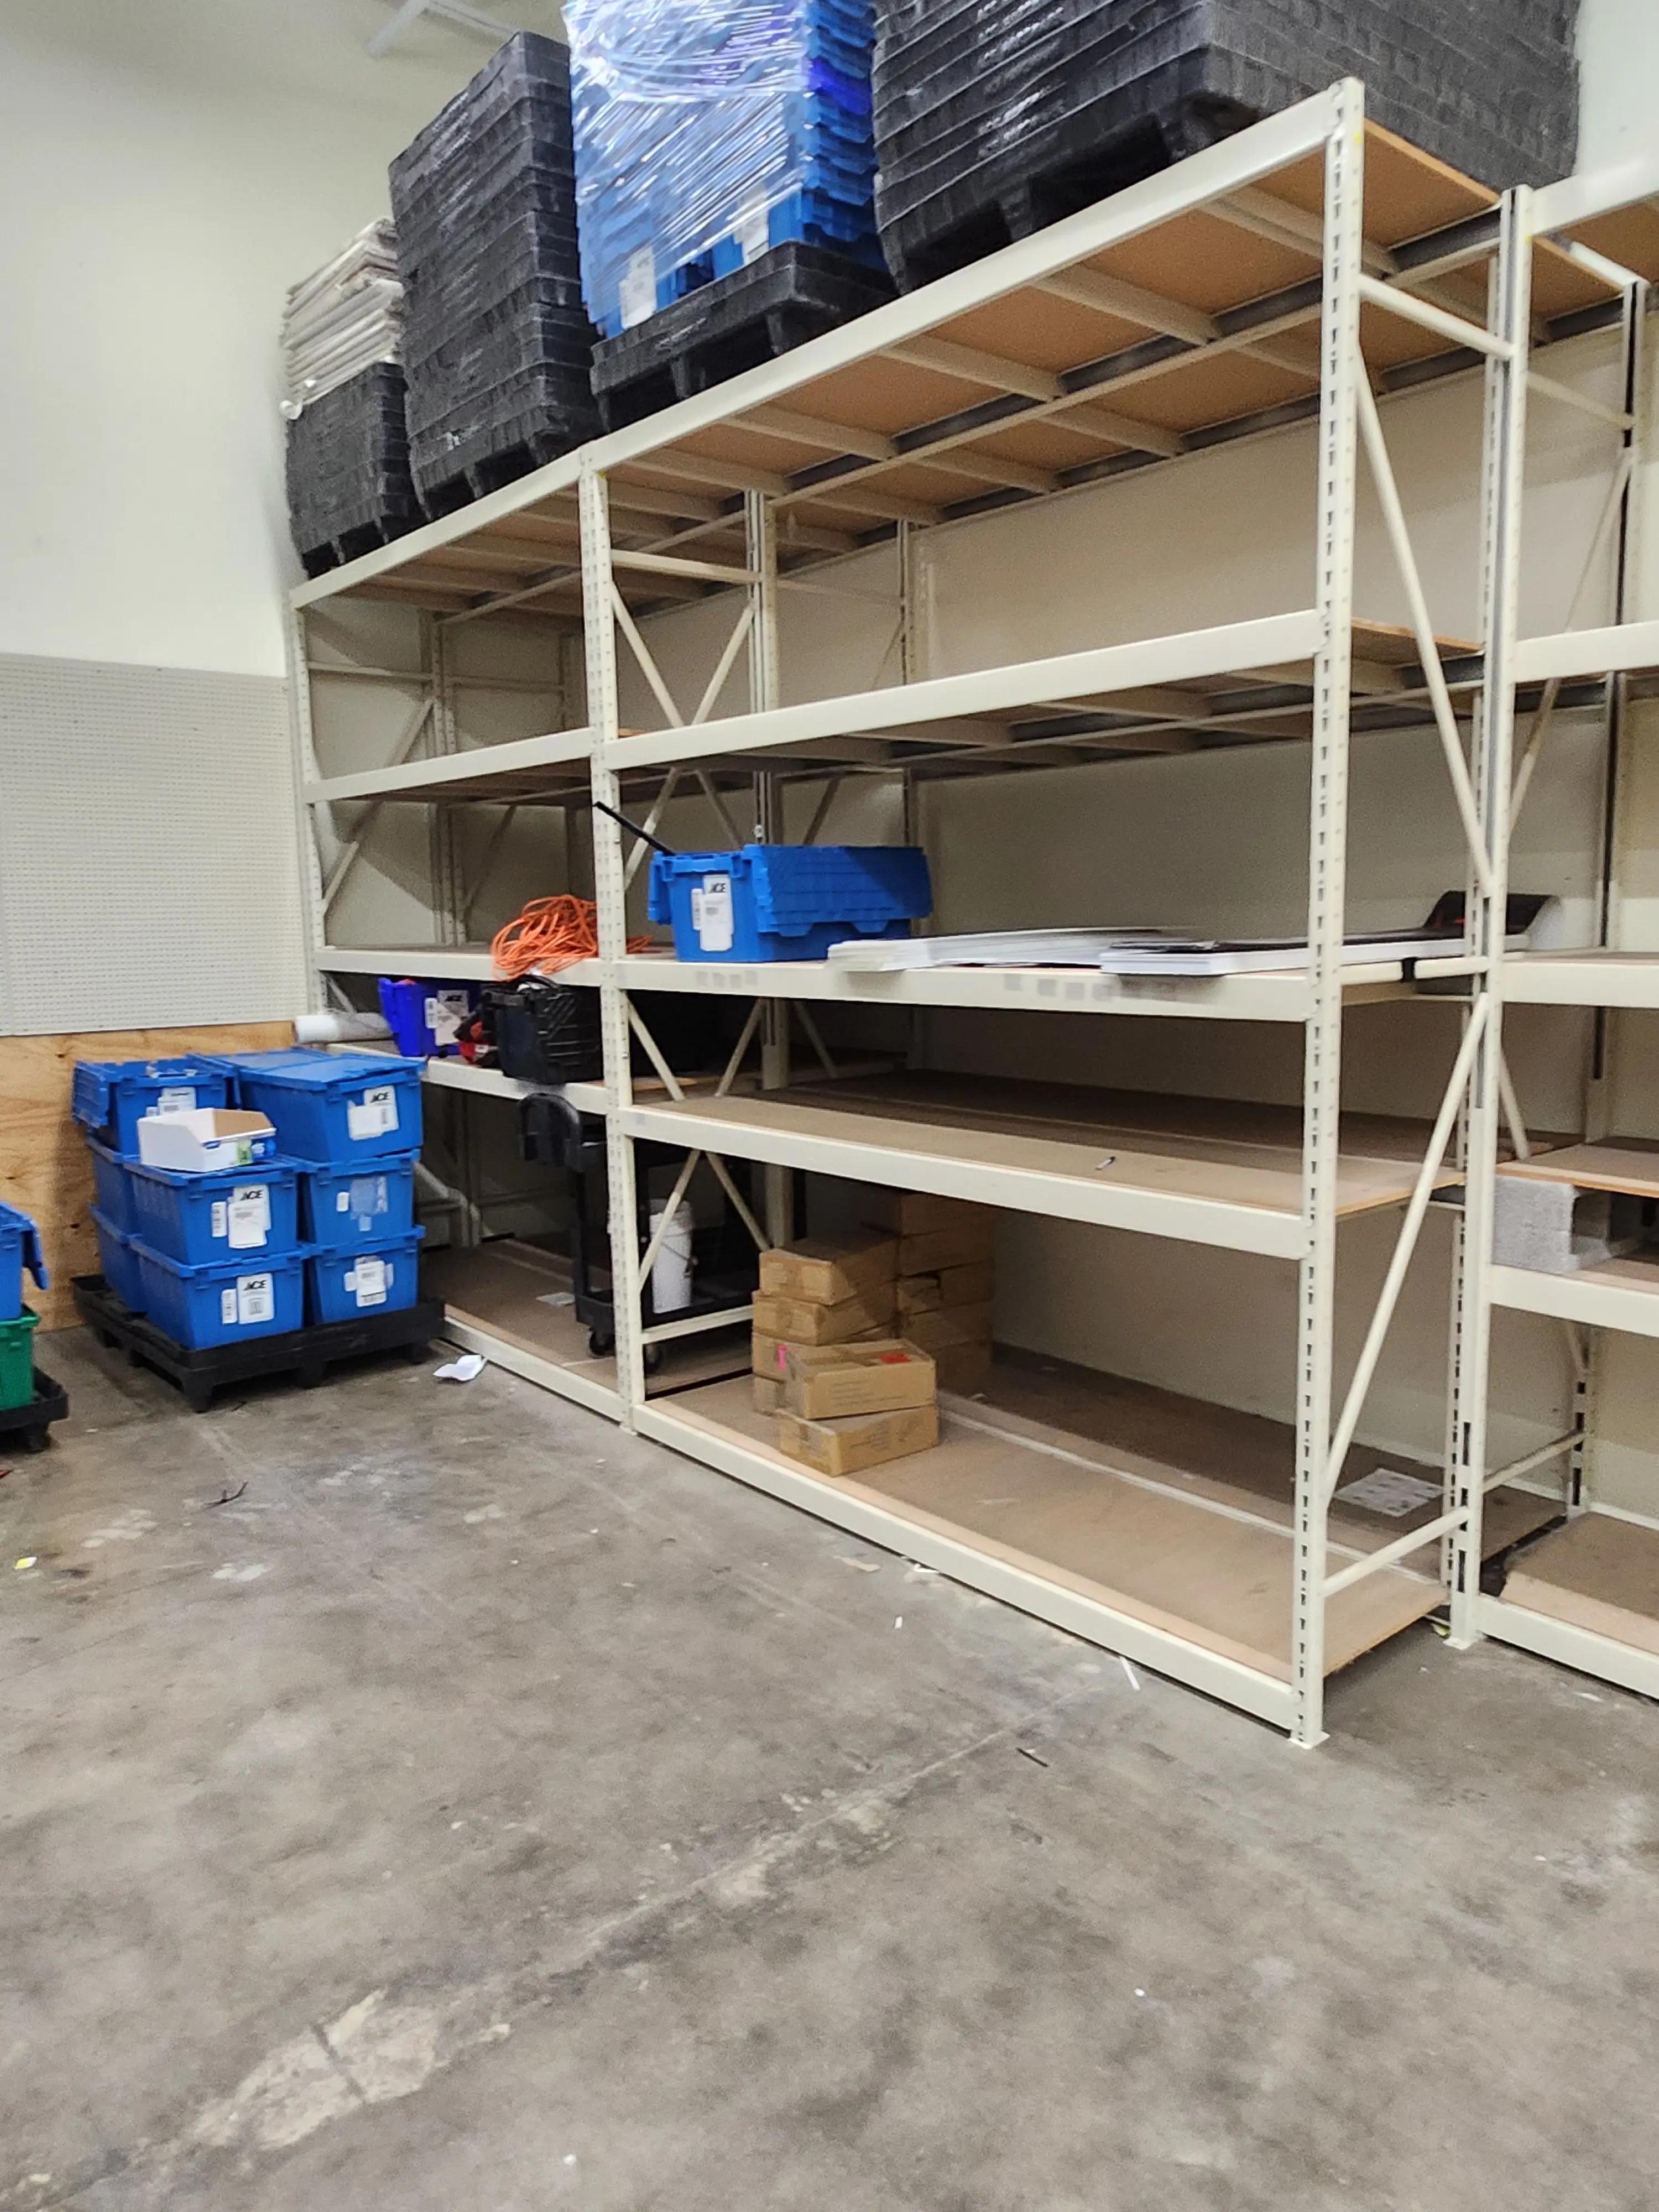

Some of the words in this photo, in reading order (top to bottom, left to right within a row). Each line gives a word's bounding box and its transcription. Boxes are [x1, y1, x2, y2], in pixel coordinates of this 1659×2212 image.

[370, 1092, 389, 1103] ACE
[239, 1189, 263, 1201] ACE
[243, 1280, 267, 1291] ACE
